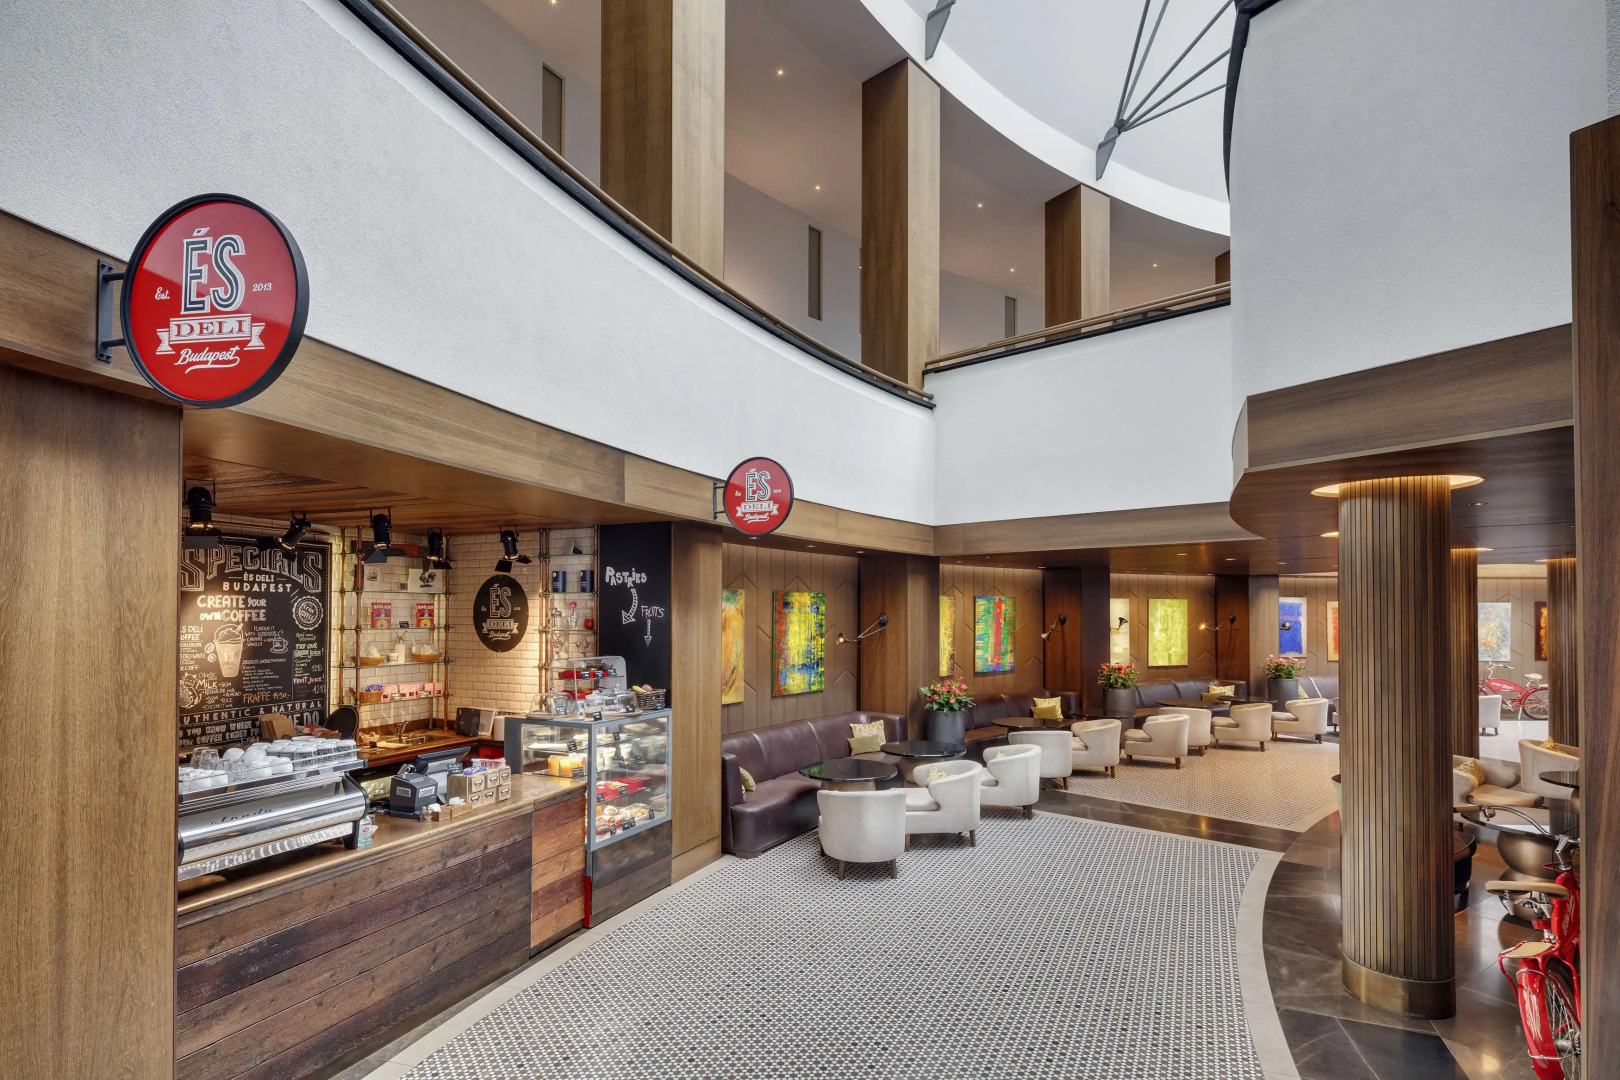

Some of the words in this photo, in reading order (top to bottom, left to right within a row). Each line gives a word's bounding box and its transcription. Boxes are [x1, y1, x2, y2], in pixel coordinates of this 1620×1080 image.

[180, 227, 245, 314] ÉS
[155, 287, 170, 300] Est.
[252, 283, 272, 292] 2013
[174, 319, 247, 338] DELI
[174, 346, 240, 374] Budapest
[745, 468, 771, 502] ÉS
[743, 512, 769, 524] Budapest
[255, 574, 275, 582] DELI
[222, 581, 292, 593] BUDAPEST
[196, 594, 246, 608] CREATE
[489, 583, 512, 618] ÉS
[200, 612, 221, 621] OWN
[221, 609, 267, 622] COFFEE
[641, 605, 665, 618] FRUITS
[183, 708, 250, 725] UTHENTIC
[271, 701, 321, 713] NATURAL
